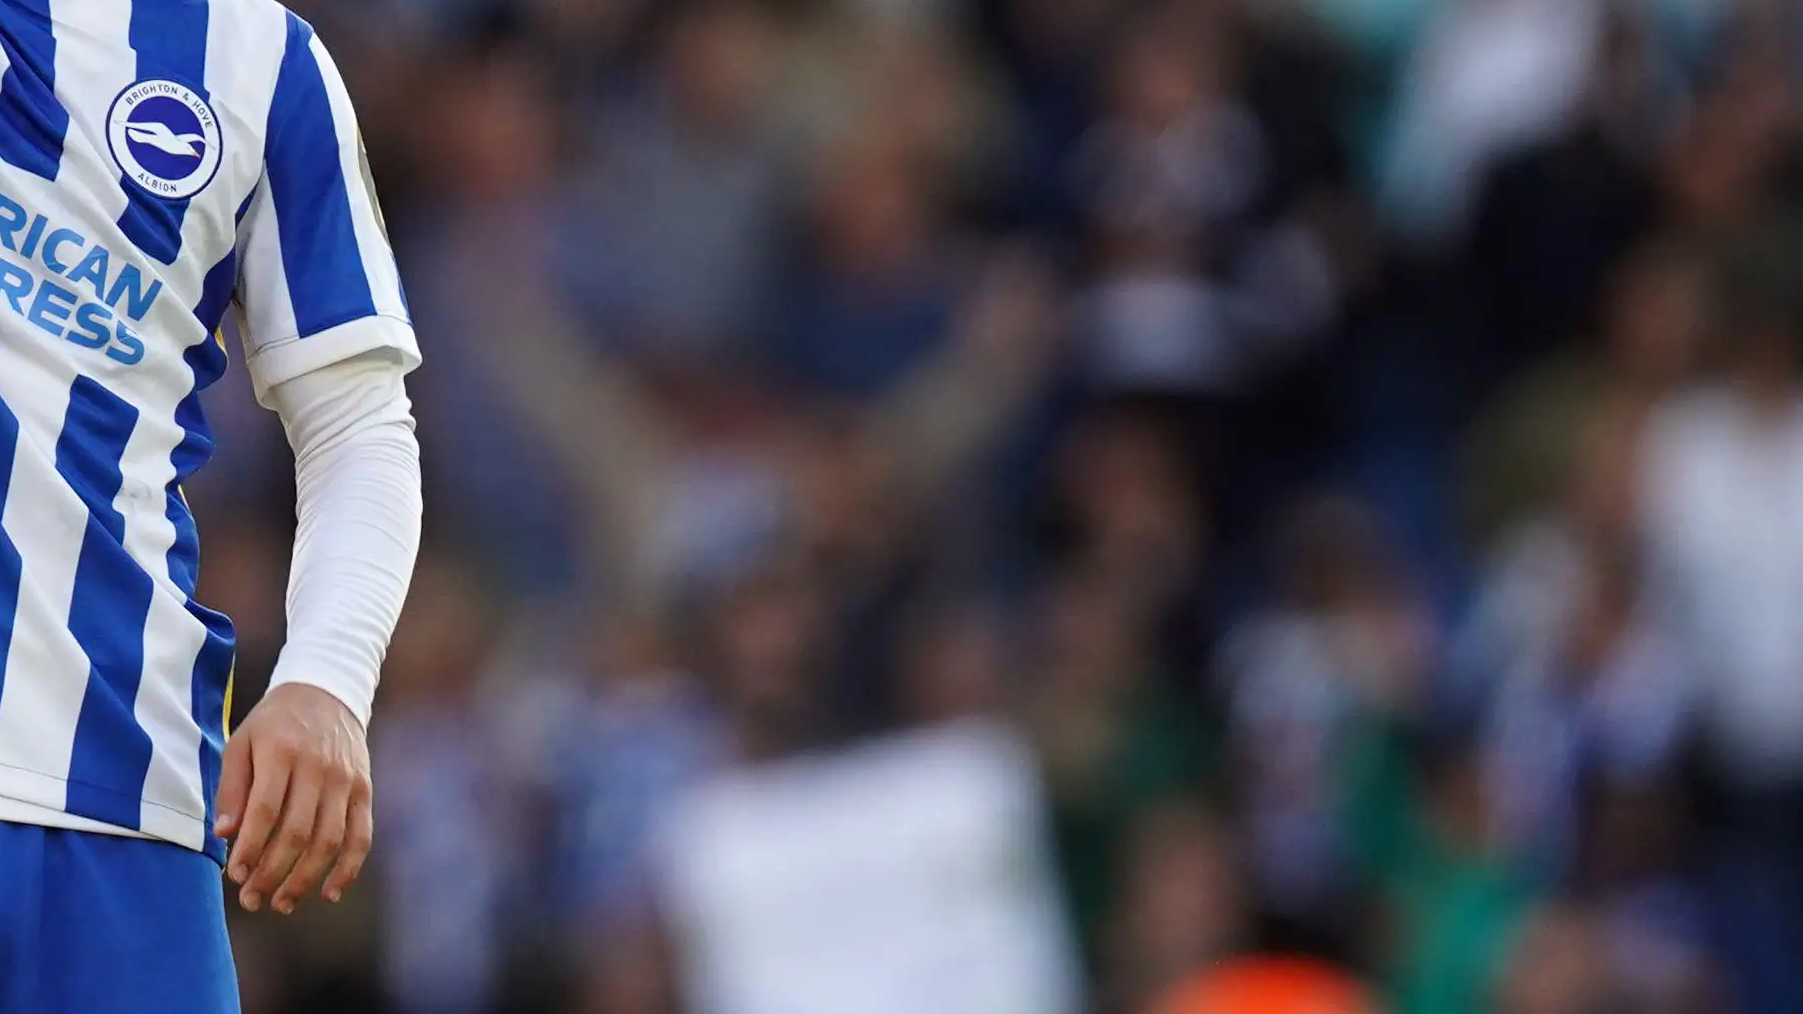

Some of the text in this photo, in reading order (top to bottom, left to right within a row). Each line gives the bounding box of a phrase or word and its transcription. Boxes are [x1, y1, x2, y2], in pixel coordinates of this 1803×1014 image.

[125, 84, 213, 128] BRIGHTON & HOVE
[137, 172, 178, 192] ALBION
